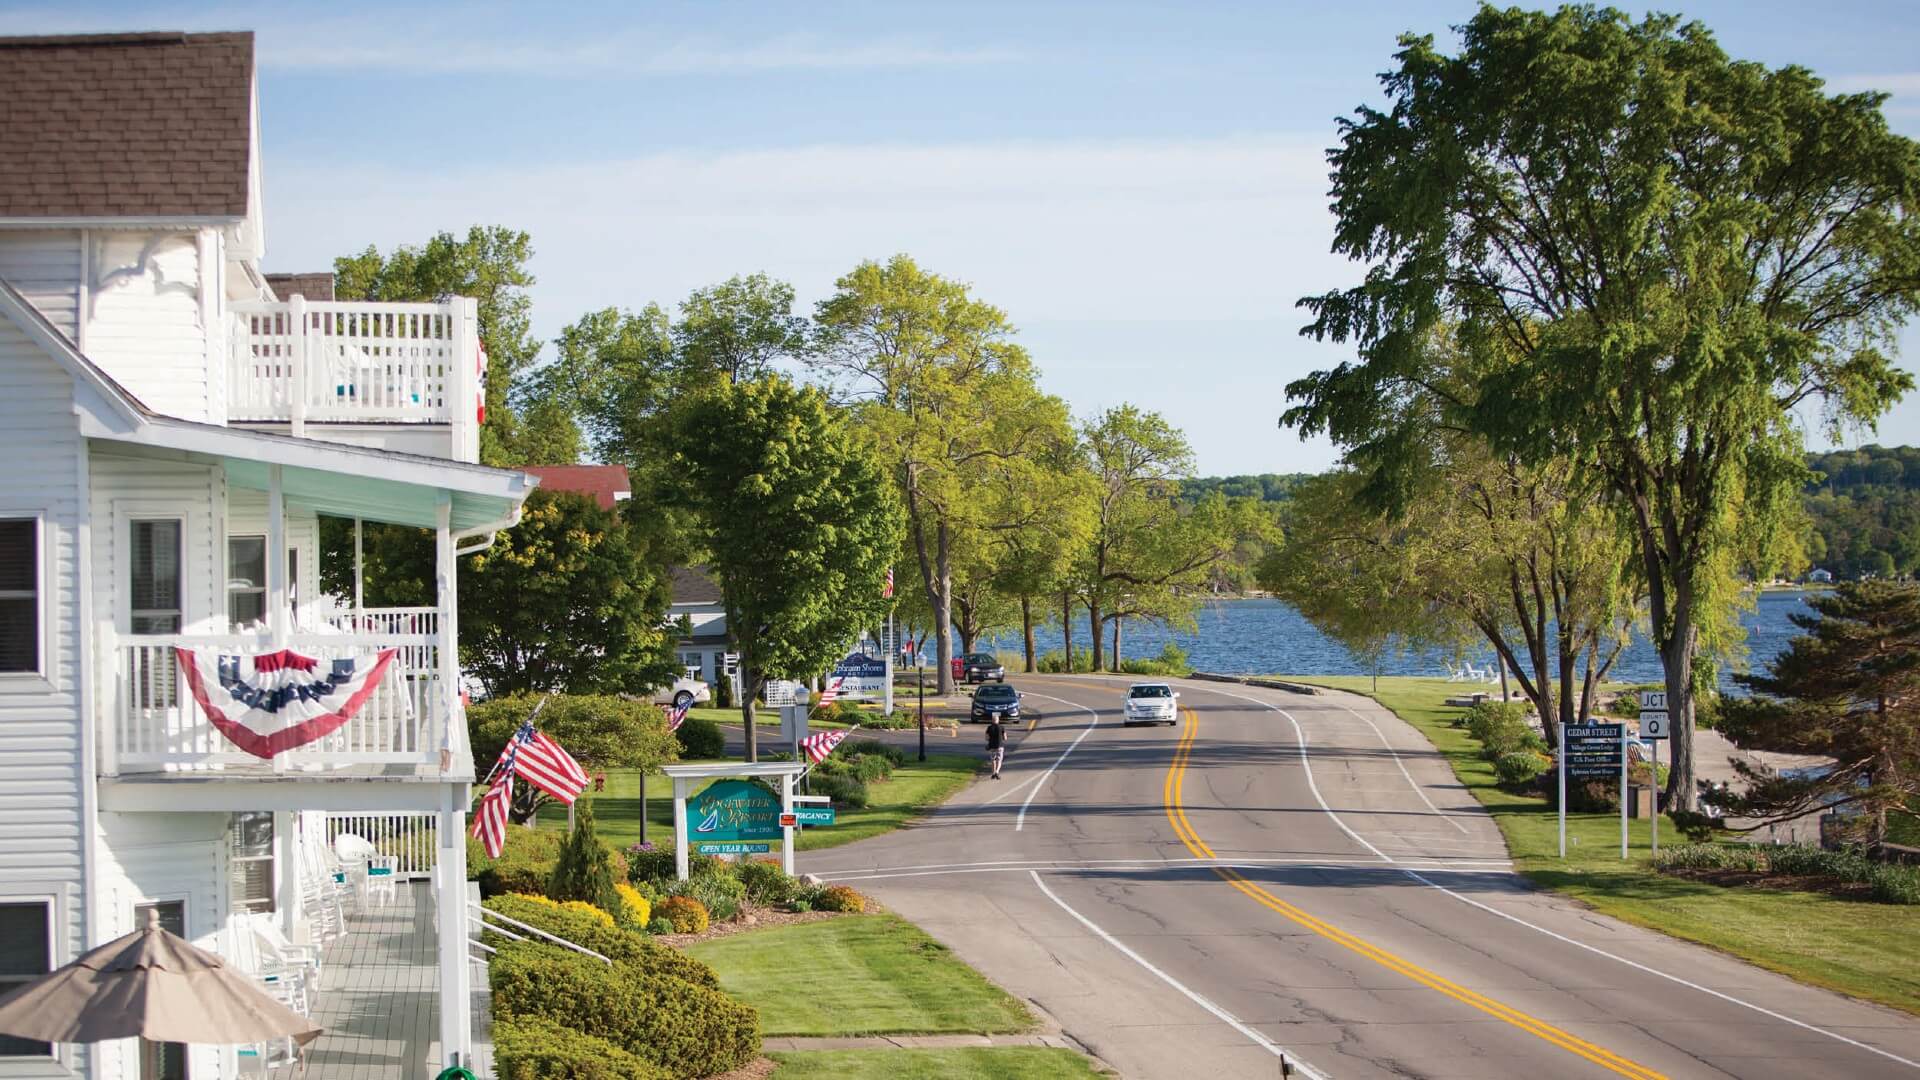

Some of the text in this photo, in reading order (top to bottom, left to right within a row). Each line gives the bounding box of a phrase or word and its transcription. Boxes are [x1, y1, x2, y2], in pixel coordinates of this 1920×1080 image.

[836, 663, 883, 674] phraim Shores
[1643, 694, 1665, 707] JCT
[1567, 728, 1617, 737] CEDAR STREET
[1648, 720, 1660, 734] Q
[700, 844, 768, 853] OPEN YEAR ROUND
